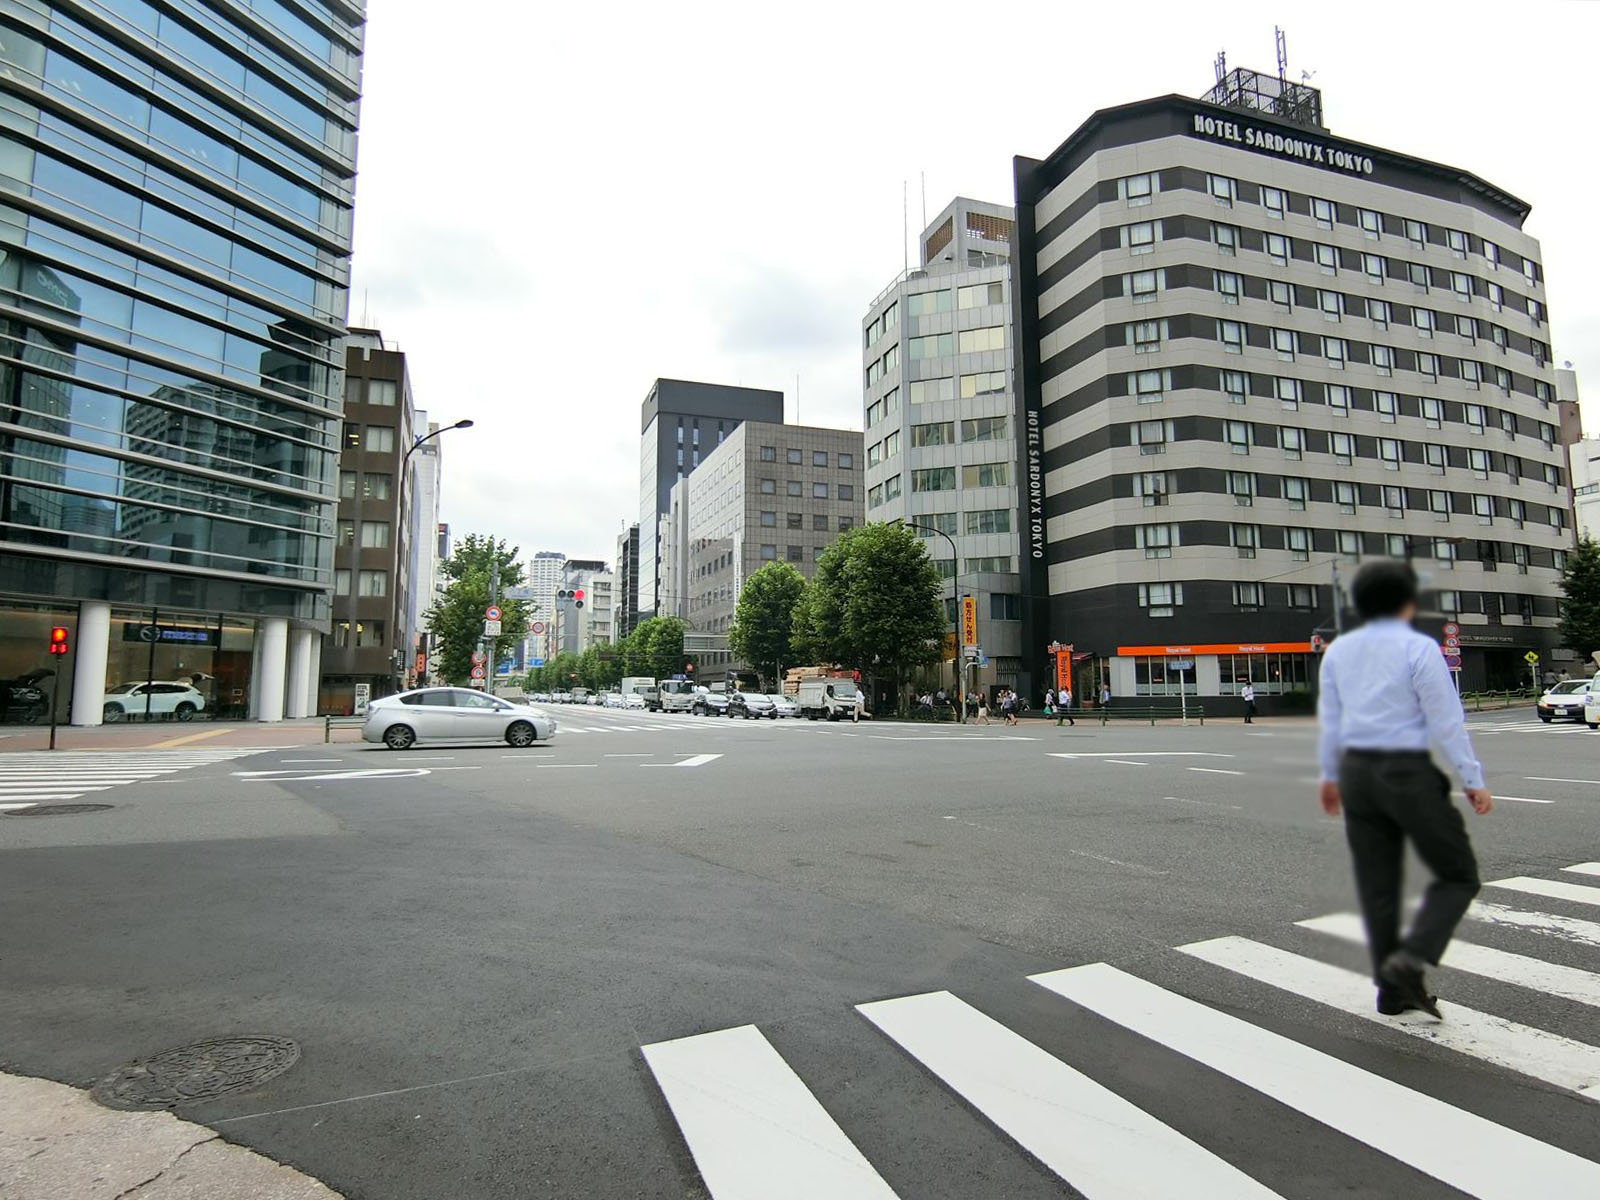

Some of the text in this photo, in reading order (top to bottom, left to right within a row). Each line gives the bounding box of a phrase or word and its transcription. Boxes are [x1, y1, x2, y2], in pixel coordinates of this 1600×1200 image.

[1194, 114, 1373, 174] HOTEL SARDONYX TOKYO
[1028, 410, 1043, 559] HOTEL SARDONYX TOKYO
